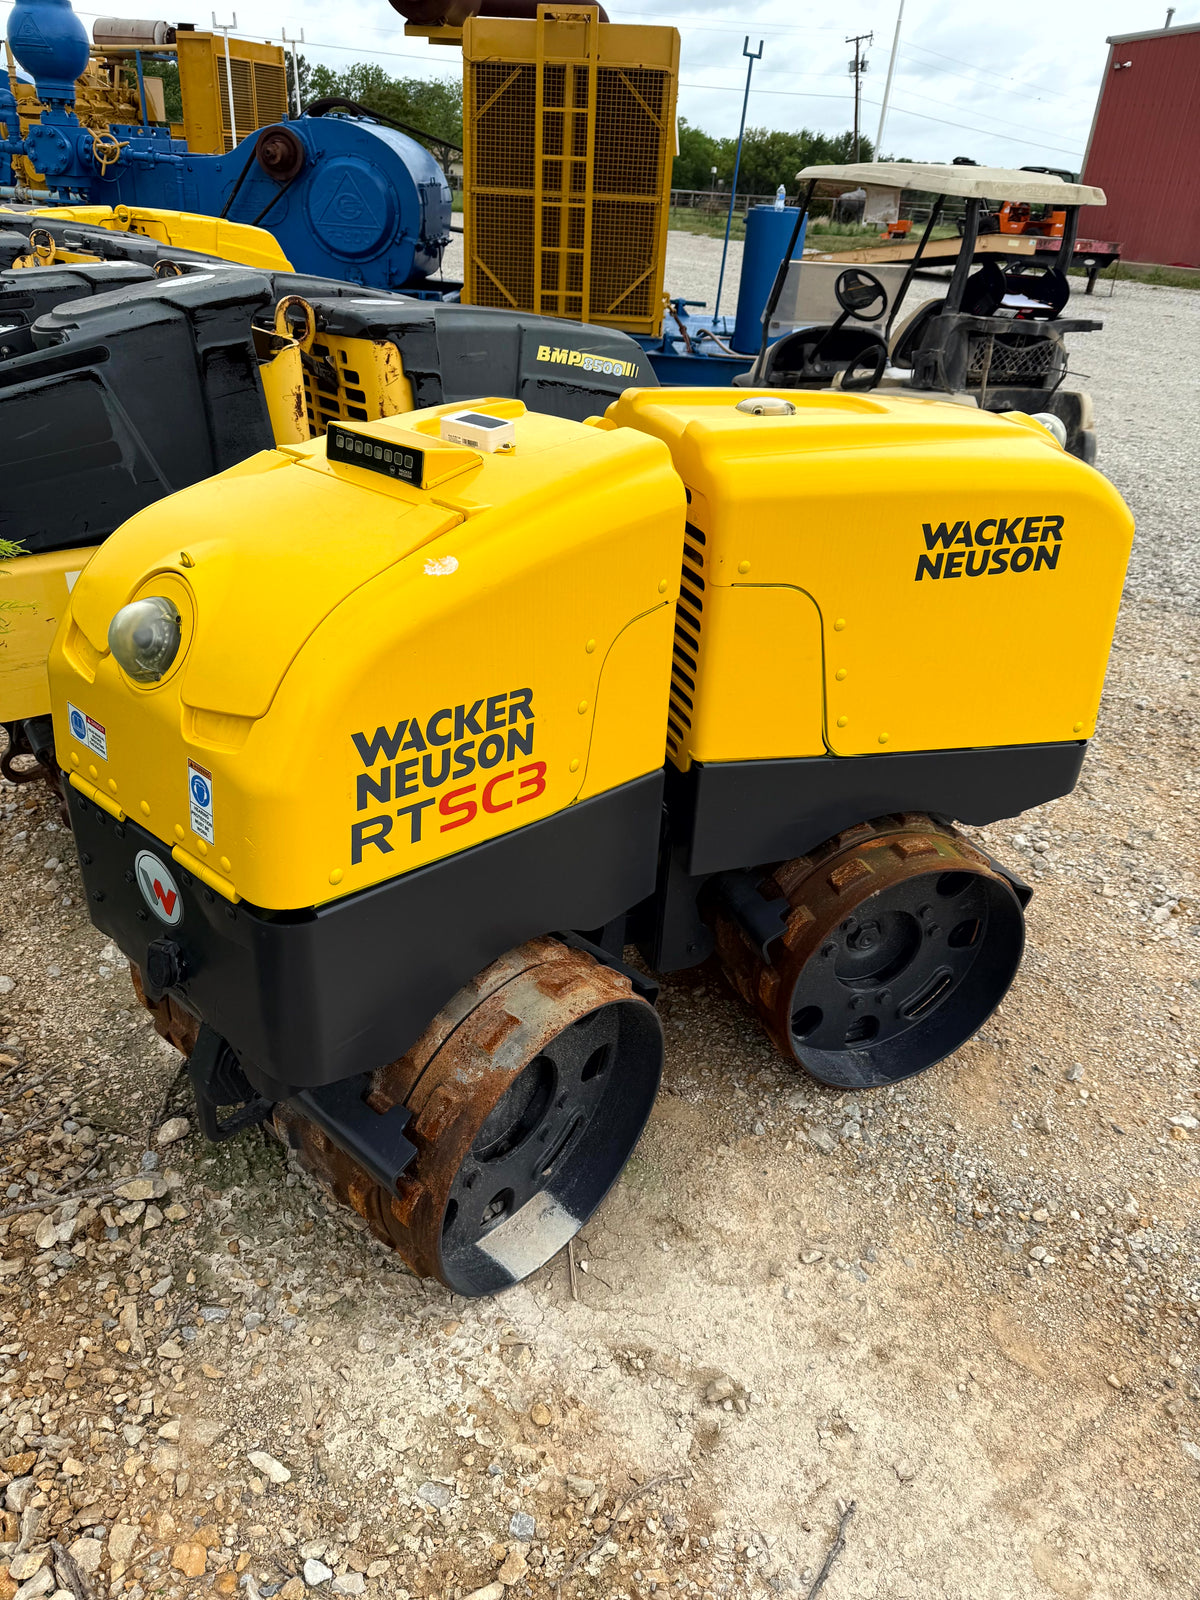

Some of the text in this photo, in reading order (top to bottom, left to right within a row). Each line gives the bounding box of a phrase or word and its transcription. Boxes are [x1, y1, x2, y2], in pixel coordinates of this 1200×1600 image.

[922, 515, 1065, 550] WACKER
[914, 544, 1062, 581] NEUSON
[350, 687, 535, 768] WACKER
[356, 722, 535, 812] NEUSON
